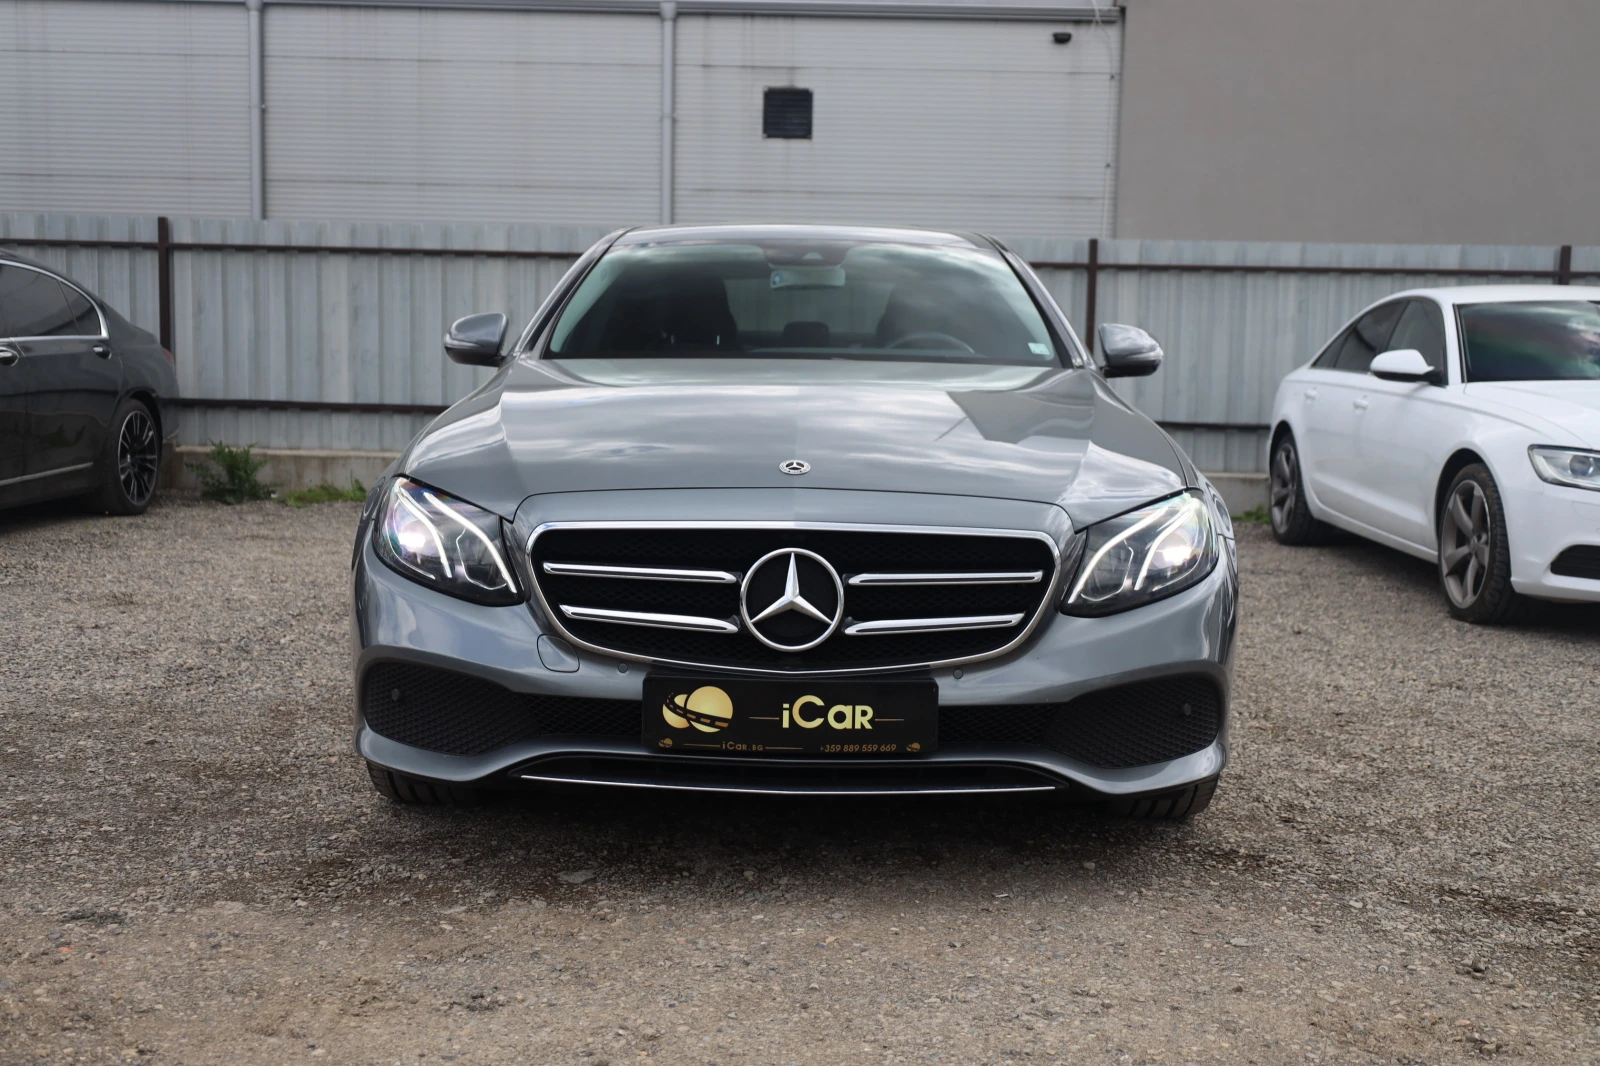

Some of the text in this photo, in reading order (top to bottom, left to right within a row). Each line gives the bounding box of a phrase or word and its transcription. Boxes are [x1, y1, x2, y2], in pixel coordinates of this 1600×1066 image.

[820, 743, 897, 753] +359 889 559 669
